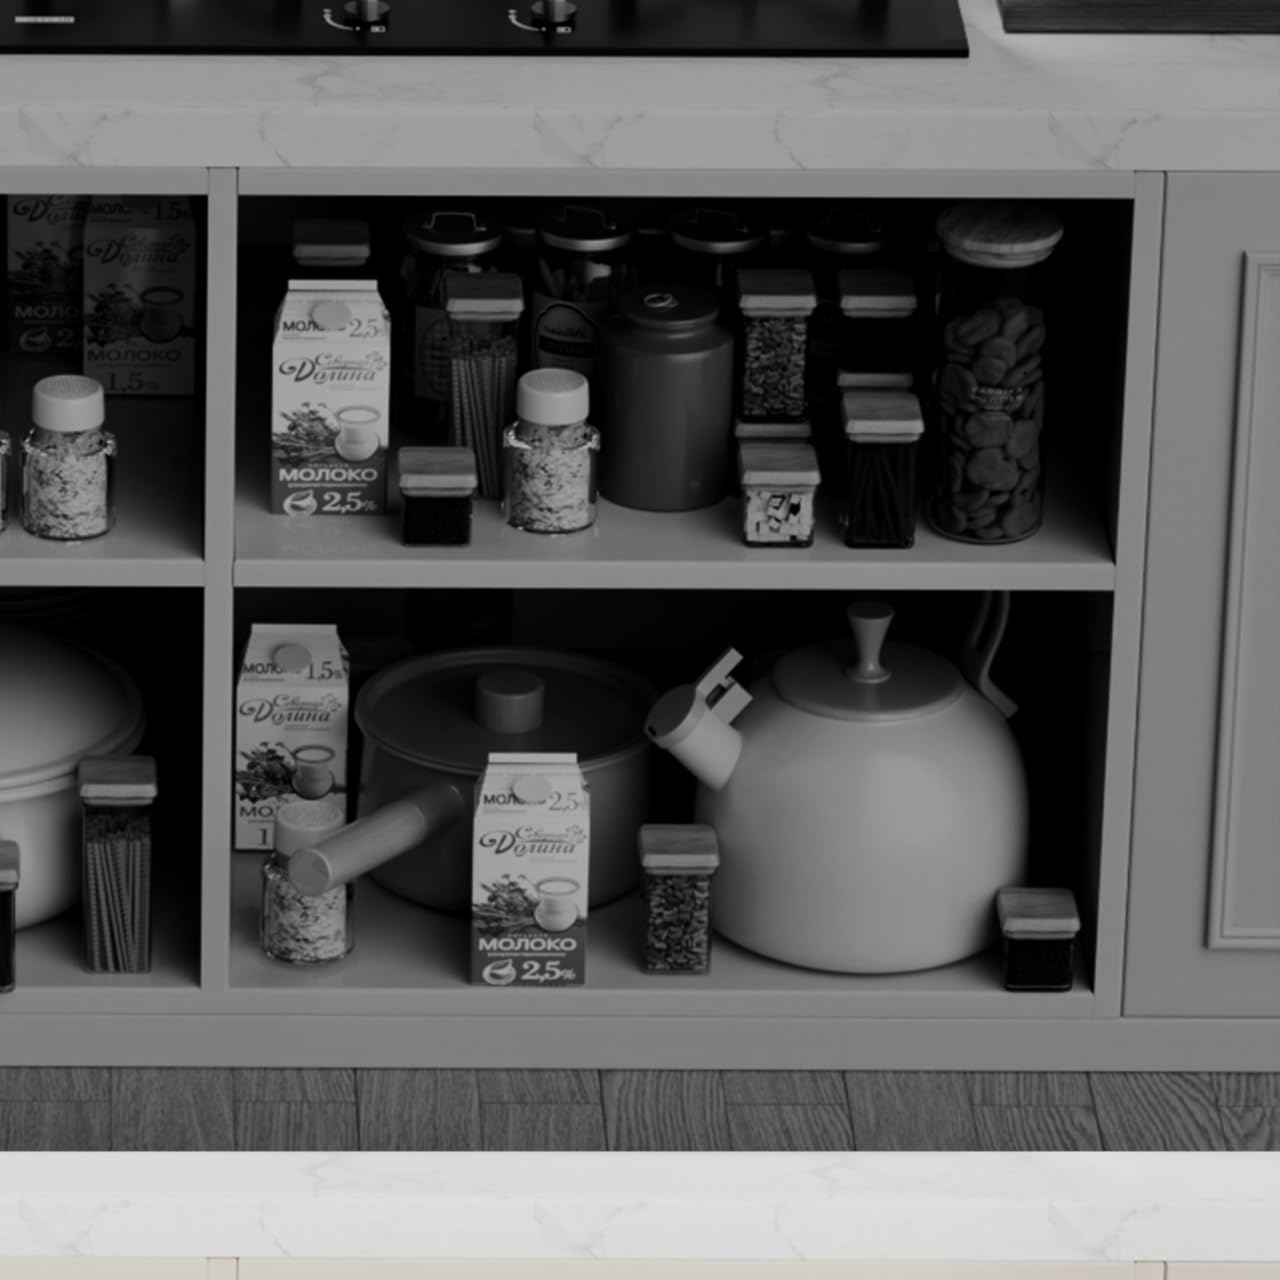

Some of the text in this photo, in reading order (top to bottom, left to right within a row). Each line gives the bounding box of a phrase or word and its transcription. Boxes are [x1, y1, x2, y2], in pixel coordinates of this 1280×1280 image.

[87, 348, 181, 362] МОЛОКО
[279, 468, 378, 482] МОЛОКО
[321, 491, 378, 514] 2,5%
[478, 937, 578, 952] МОЛОКО
[521, 960, 578, 983] 2,5%
